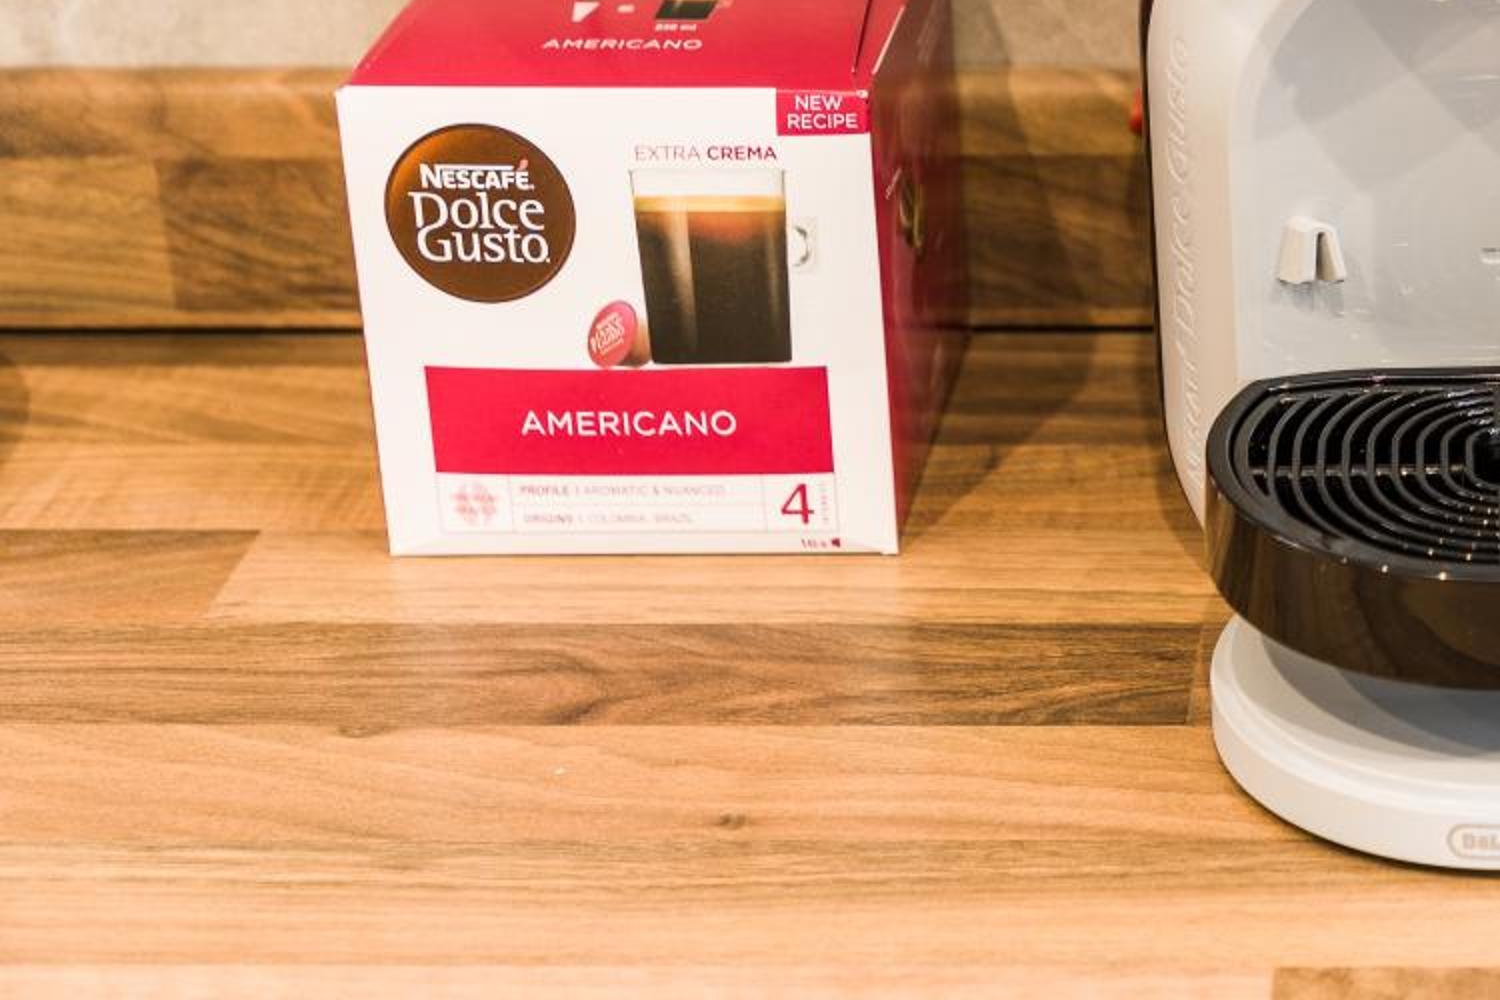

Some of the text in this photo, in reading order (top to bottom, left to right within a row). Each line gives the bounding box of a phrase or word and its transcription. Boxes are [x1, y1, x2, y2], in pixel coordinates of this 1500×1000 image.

[543, 39, 702, 50] AMERICANO
[795, 95, 842, 111] NEW
[787, 113, 858, 129] RECIPE
[635, 145, 777, 160] EXTRA CREMA
[408, 191, 545, 231] Dolce
[417, 227, 550, 263] Gusto
[521, 410, 737, 436] AMERICANO
[781, 483, 815, 524] 4
